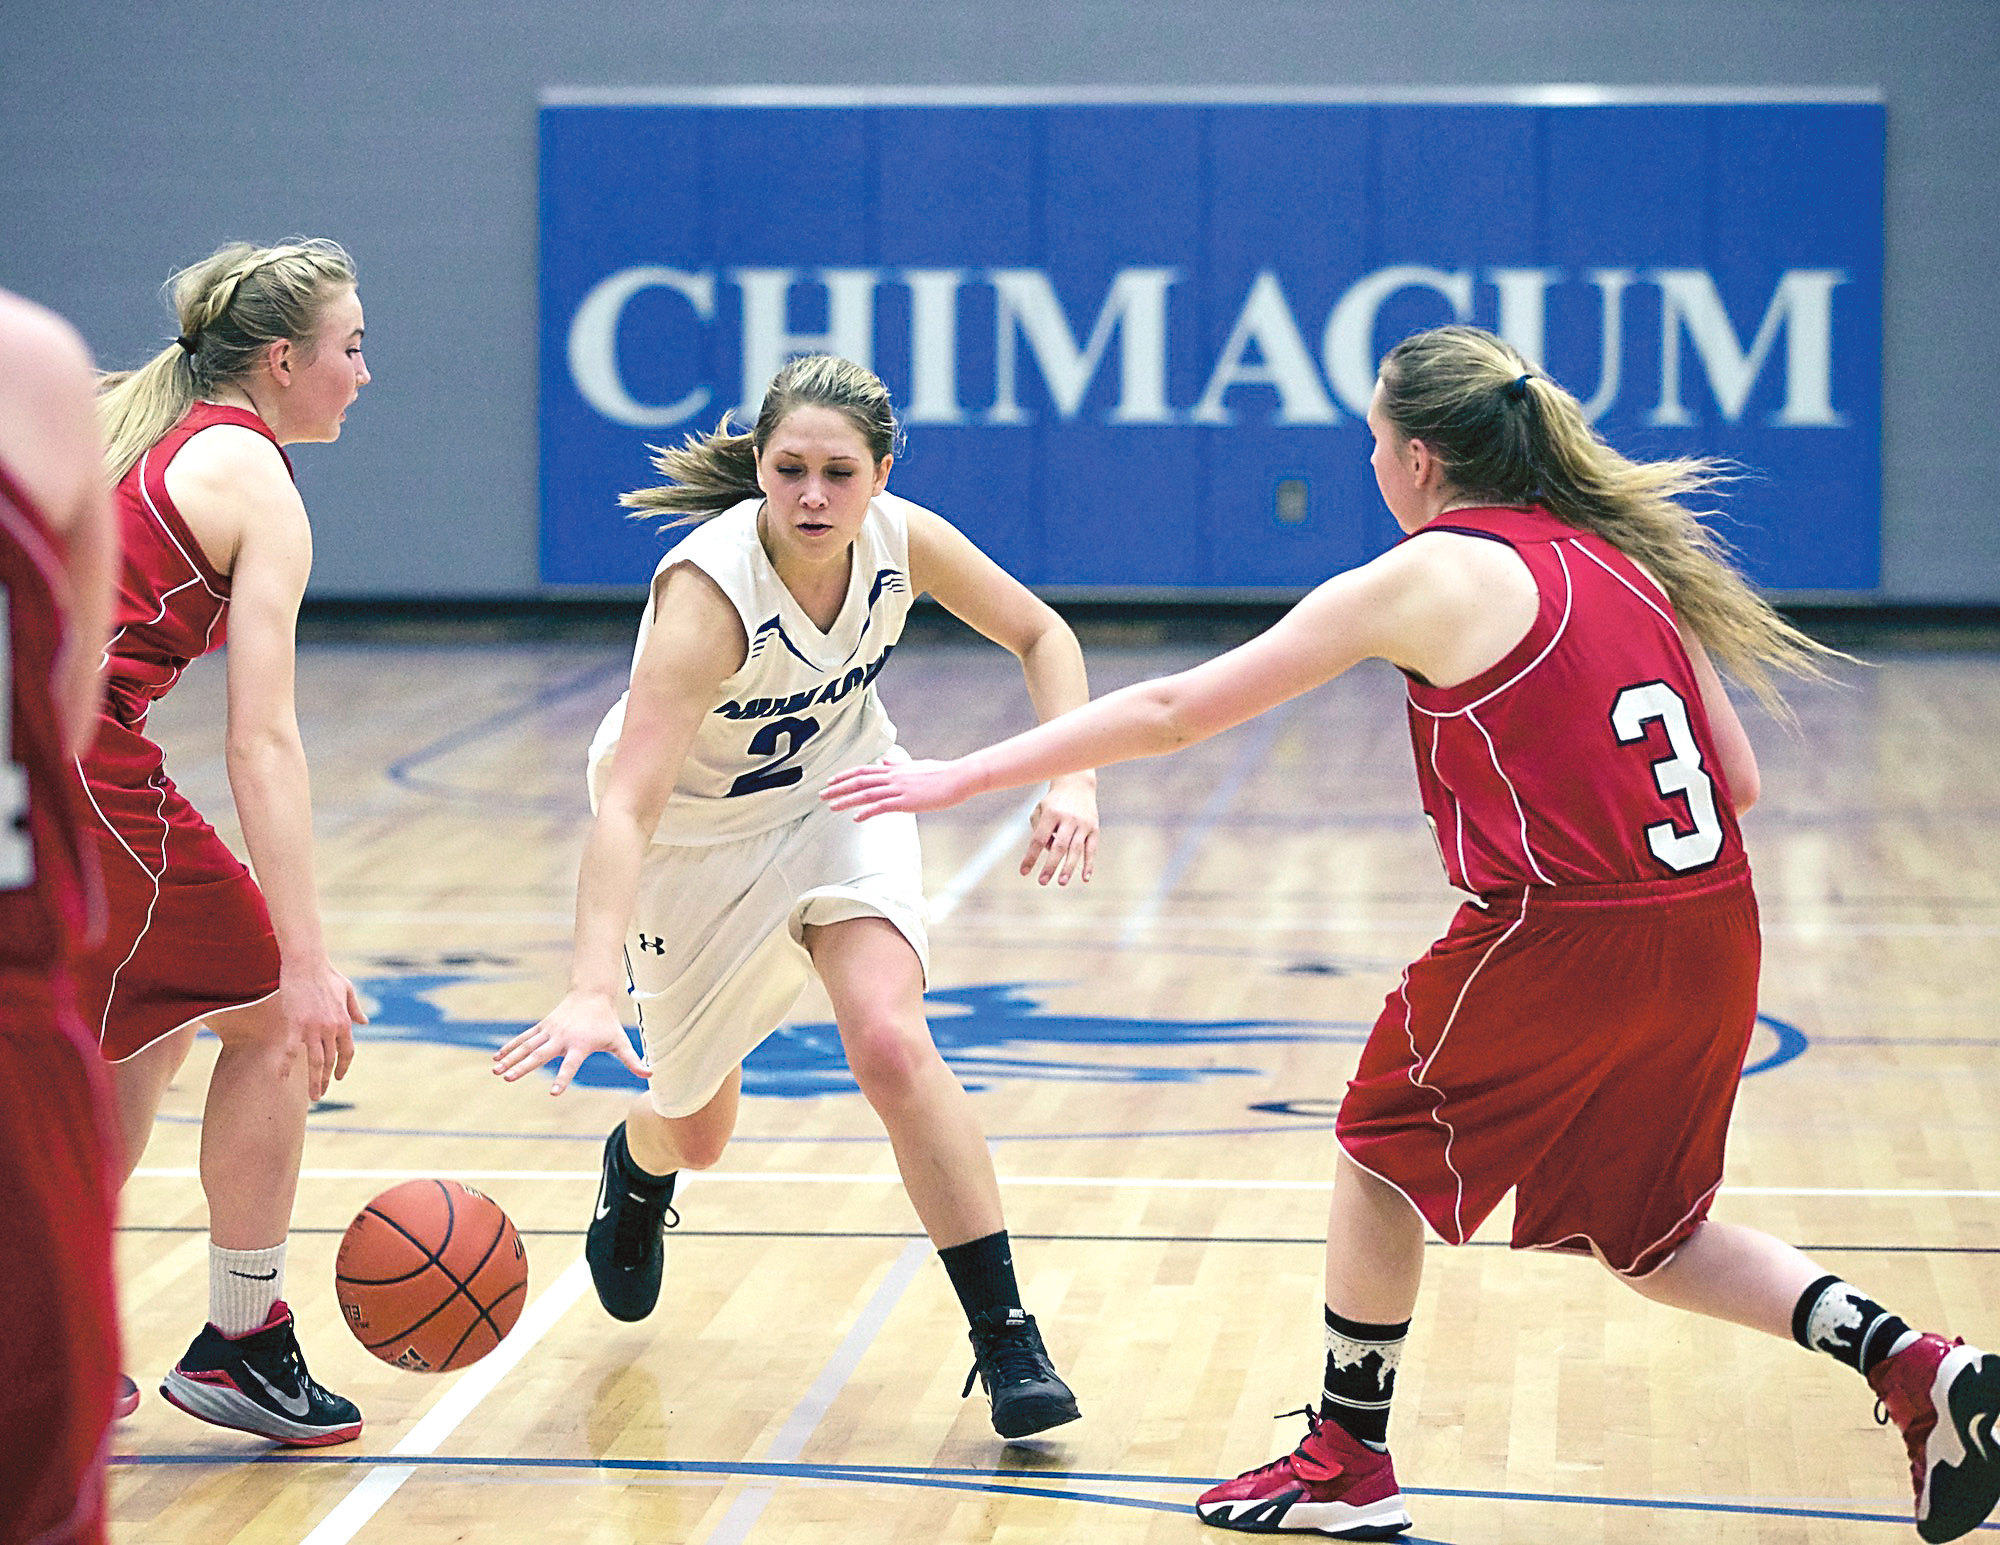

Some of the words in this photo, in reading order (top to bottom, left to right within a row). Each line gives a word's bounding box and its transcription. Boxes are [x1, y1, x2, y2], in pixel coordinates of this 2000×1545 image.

[567, 265, 1851, 428] CHIMACUM
[721, 716, 821, 798] 2
[1611, 678, 1724, 875] 3
